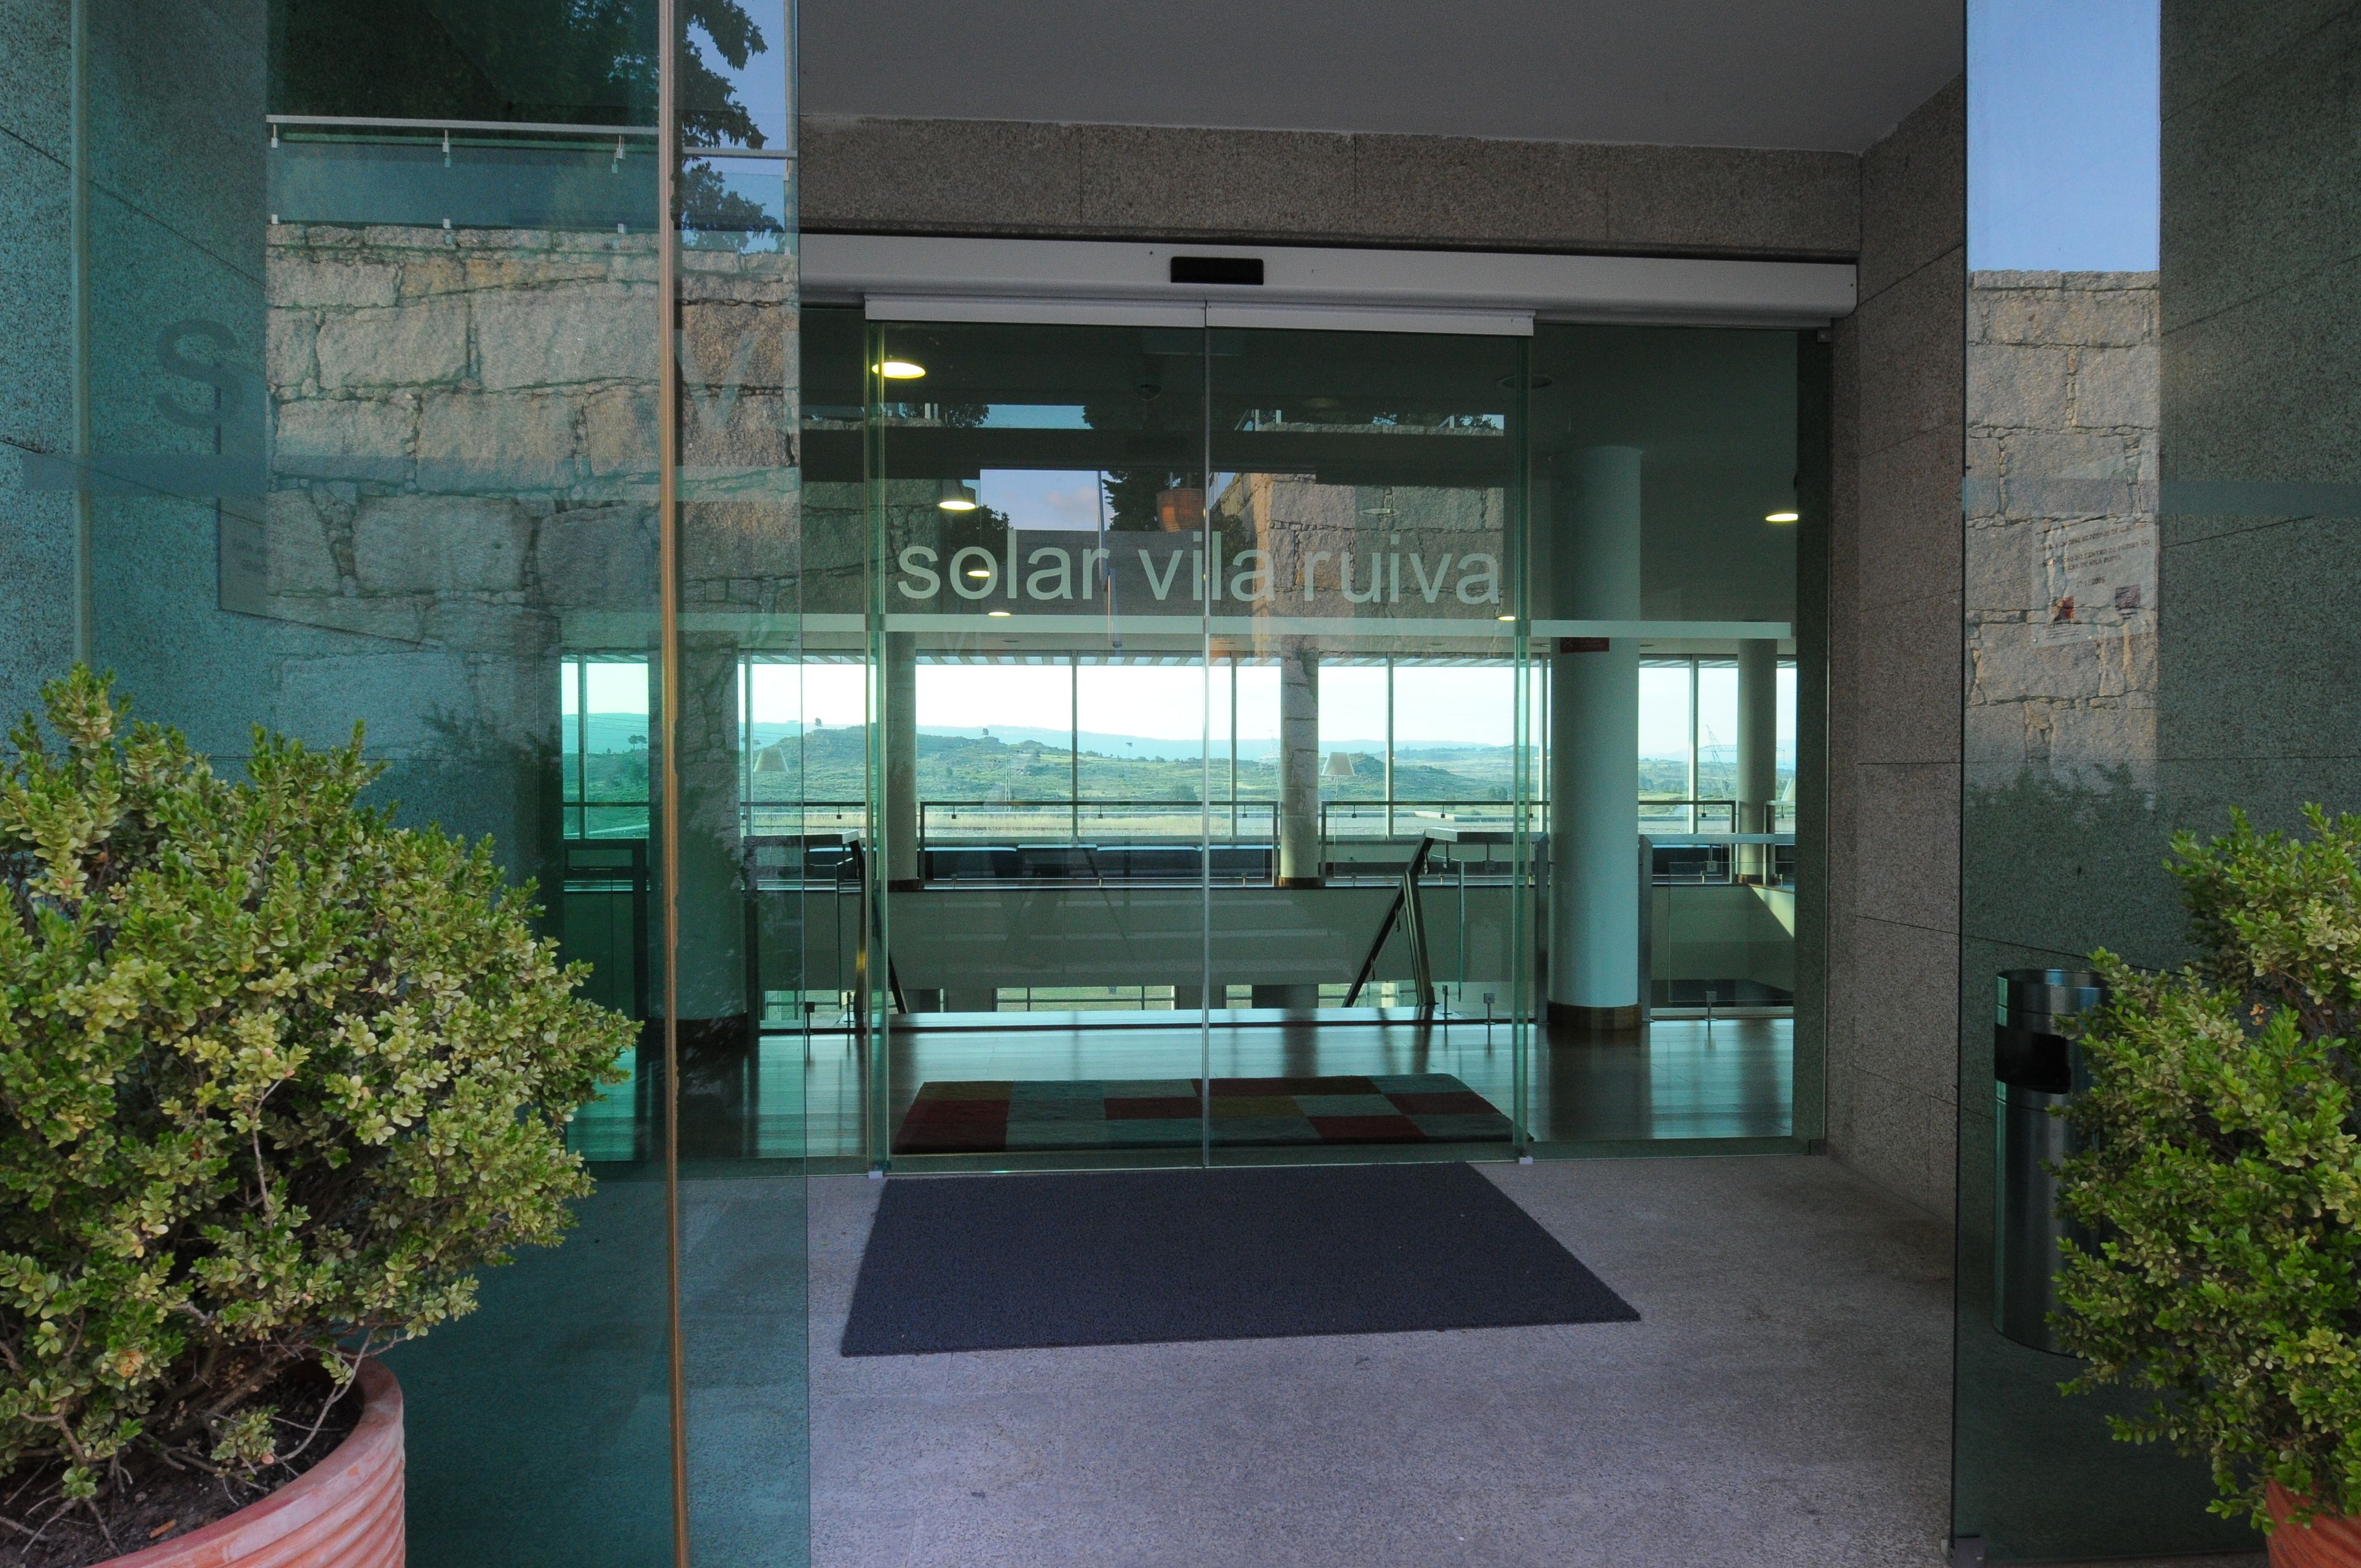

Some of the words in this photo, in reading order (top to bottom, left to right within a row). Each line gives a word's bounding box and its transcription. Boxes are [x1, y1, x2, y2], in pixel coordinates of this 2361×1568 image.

[898, 529, 1110, 600] solar
[1137, 531, 1276, 601] vila
[1303, 533, 1501, 605] ruiva
